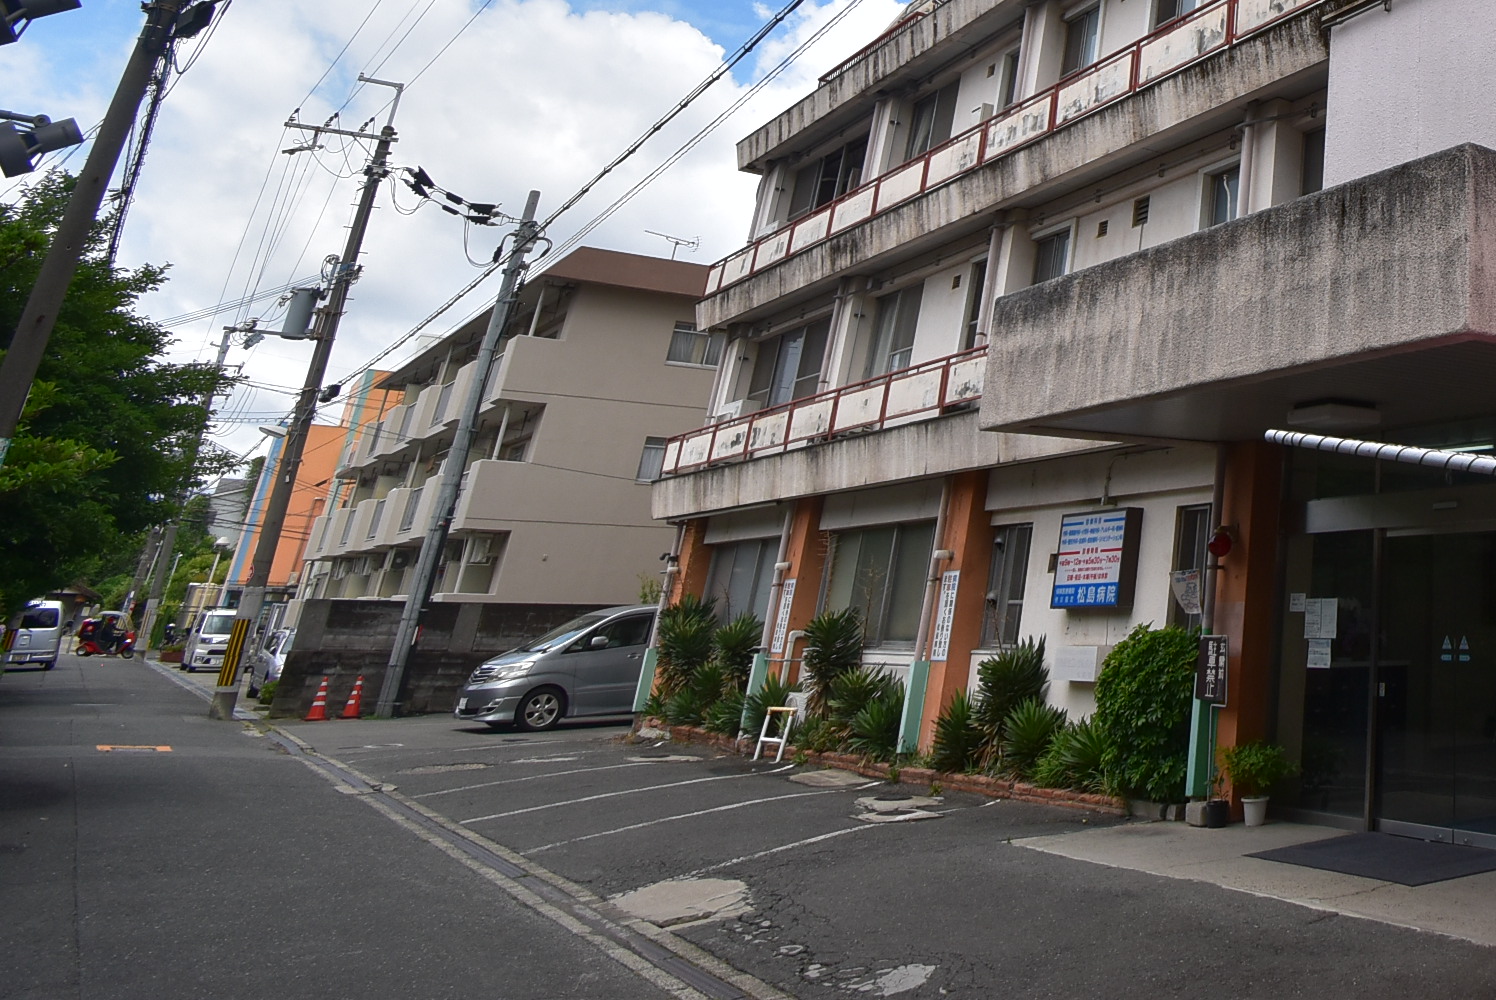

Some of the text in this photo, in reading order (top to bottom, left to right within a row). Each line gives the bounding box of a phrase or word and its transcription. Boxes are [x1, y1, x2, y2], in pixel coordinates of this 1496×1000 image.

[1077, 585, 1117, 603] 松島病院
[1205, 641, 1218, 698] 駐車禁止
